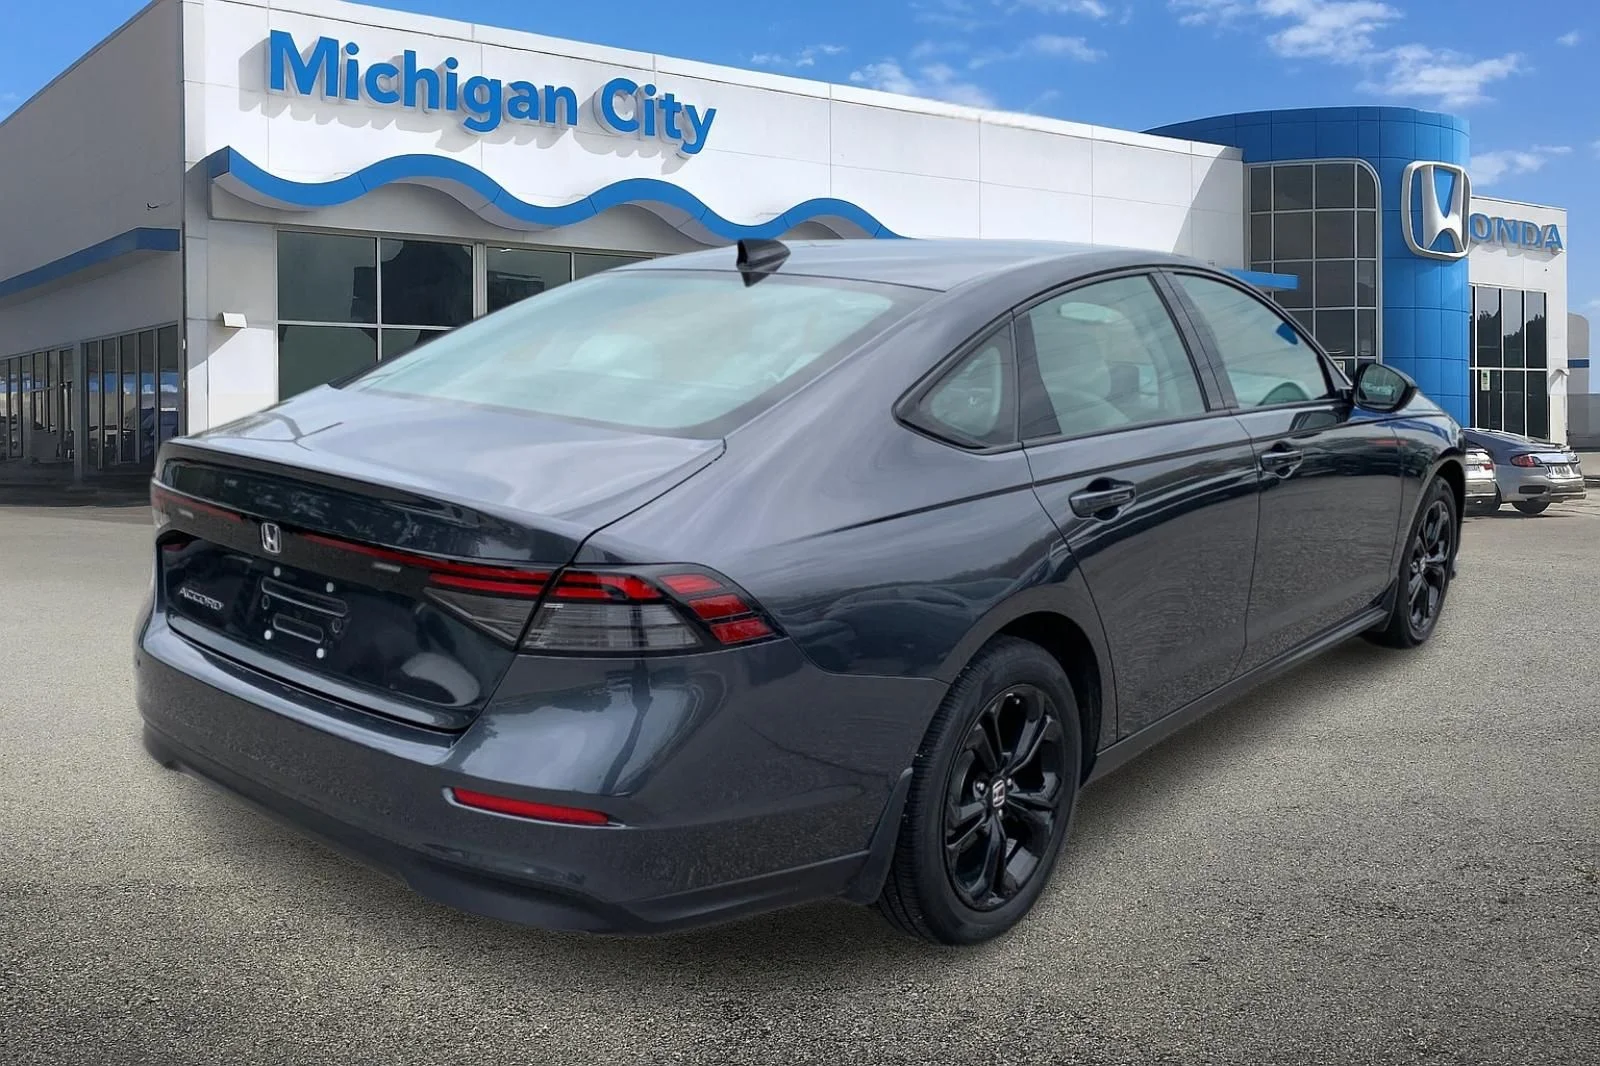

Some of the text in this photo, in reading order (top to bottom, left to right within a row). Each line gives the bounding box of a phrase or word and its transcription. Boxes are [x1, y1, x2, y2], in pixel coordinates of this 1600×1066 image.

[269, 29, 717, 155] Michigan City
[1469, 212, 1564, 250] ONDA
